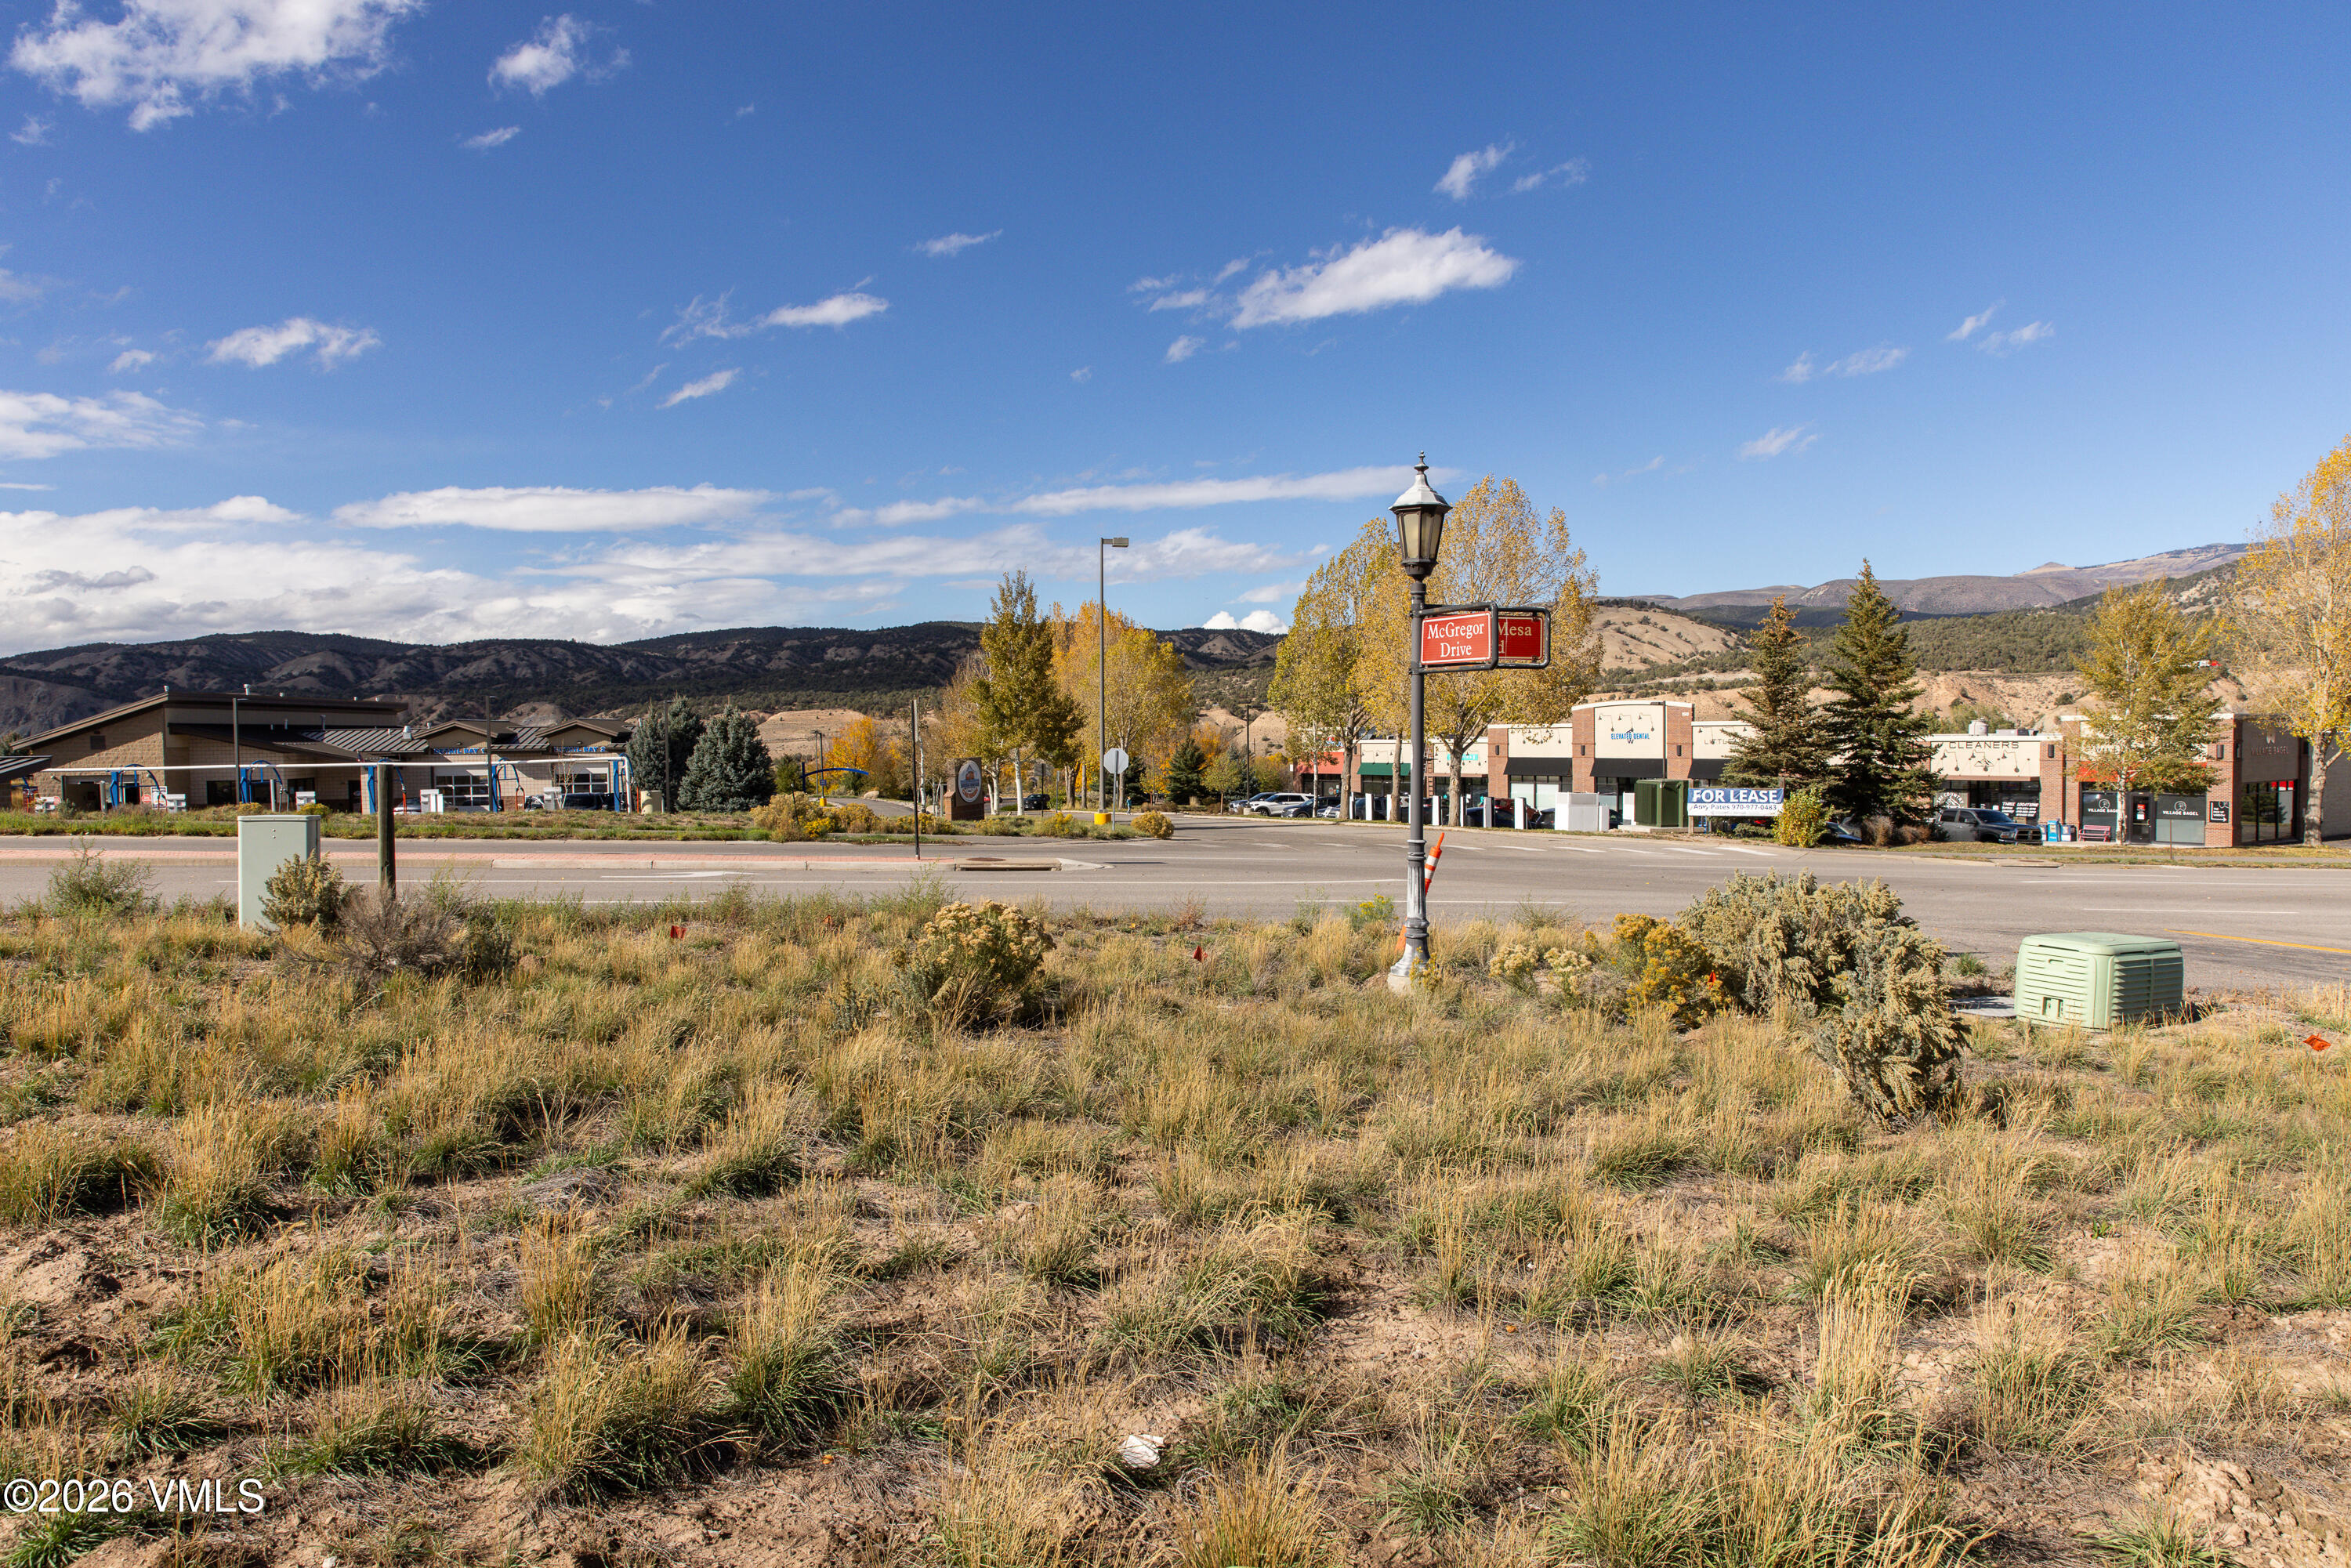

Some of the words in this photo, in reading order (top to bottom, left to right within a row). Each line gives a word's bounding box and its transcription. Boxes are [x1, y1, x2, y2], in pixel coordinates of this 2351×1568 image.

[1427, 622, 1484, 639] McGregor
[1498, 622, 1532, 636] Mesa
[1440, 642, 1472, 657] Drive
[1692, 789, 1726, 802] FOR
[1730, 789, 1778, 803] LEASE
[1943, 791, 1964, 804] COUNTRY
